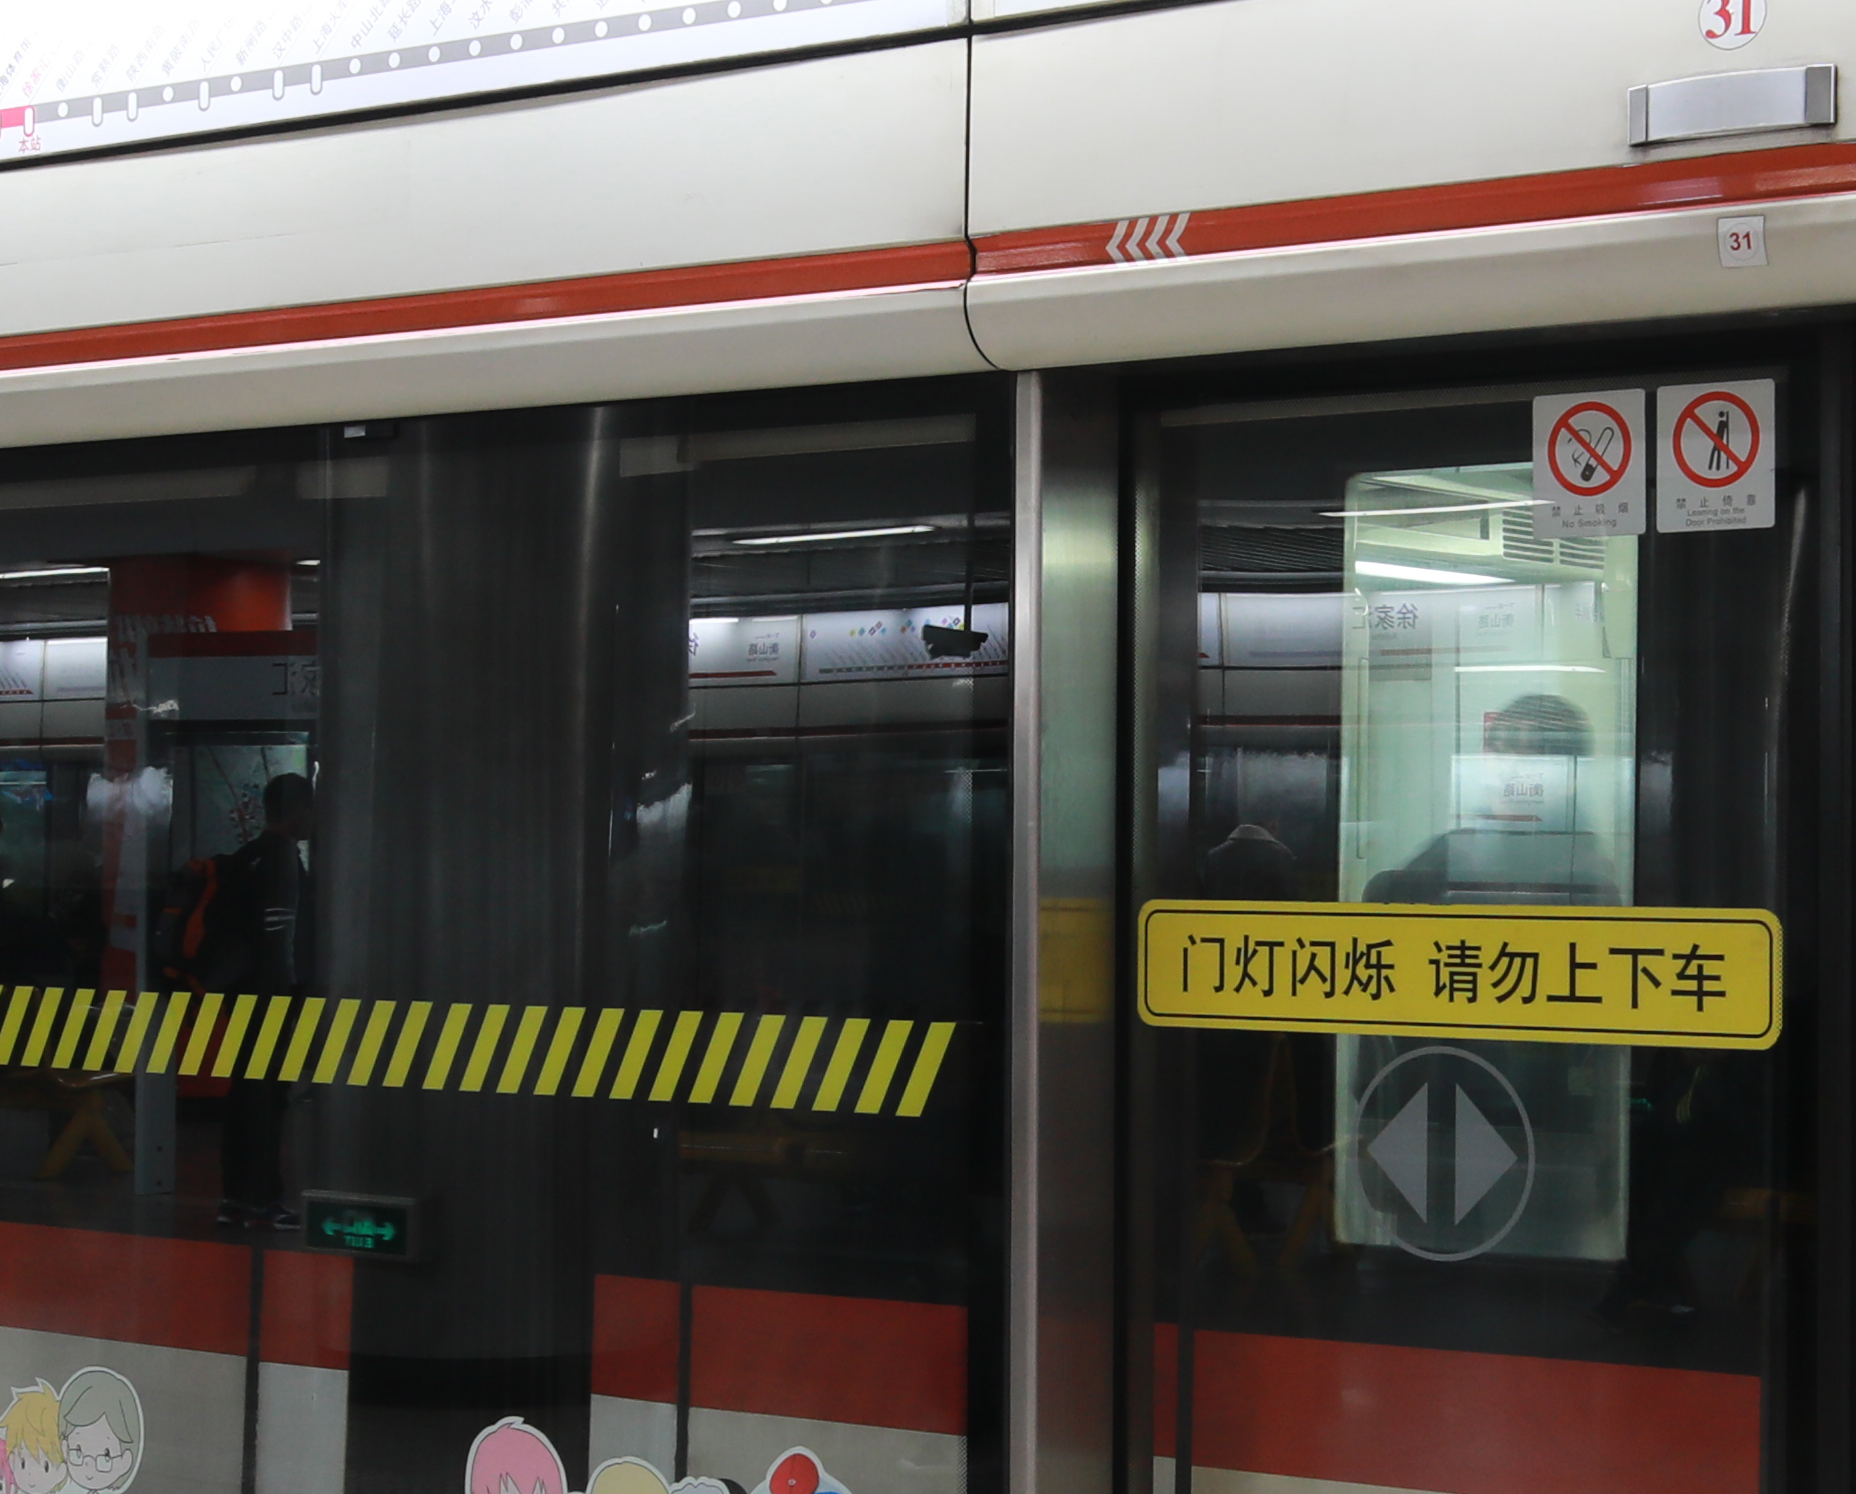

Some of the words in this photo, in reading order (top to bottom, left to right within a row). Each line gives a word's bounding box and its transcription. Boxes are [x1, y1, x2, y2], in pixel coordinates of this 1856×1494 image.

[1729, 232, 1752, 251] 31
[1552, 502, 1629, 518] 禁止吸烟
[1676, 494, 1756, 510] 禁止倚靠
[1562, 519, 1574, 529] No
[1577, 517, 1617, 529] Smoking
[1181, 933, 1396, 1002] 门灯闪烁
[1428, 939, 1728, 1013] 请勿上下车
